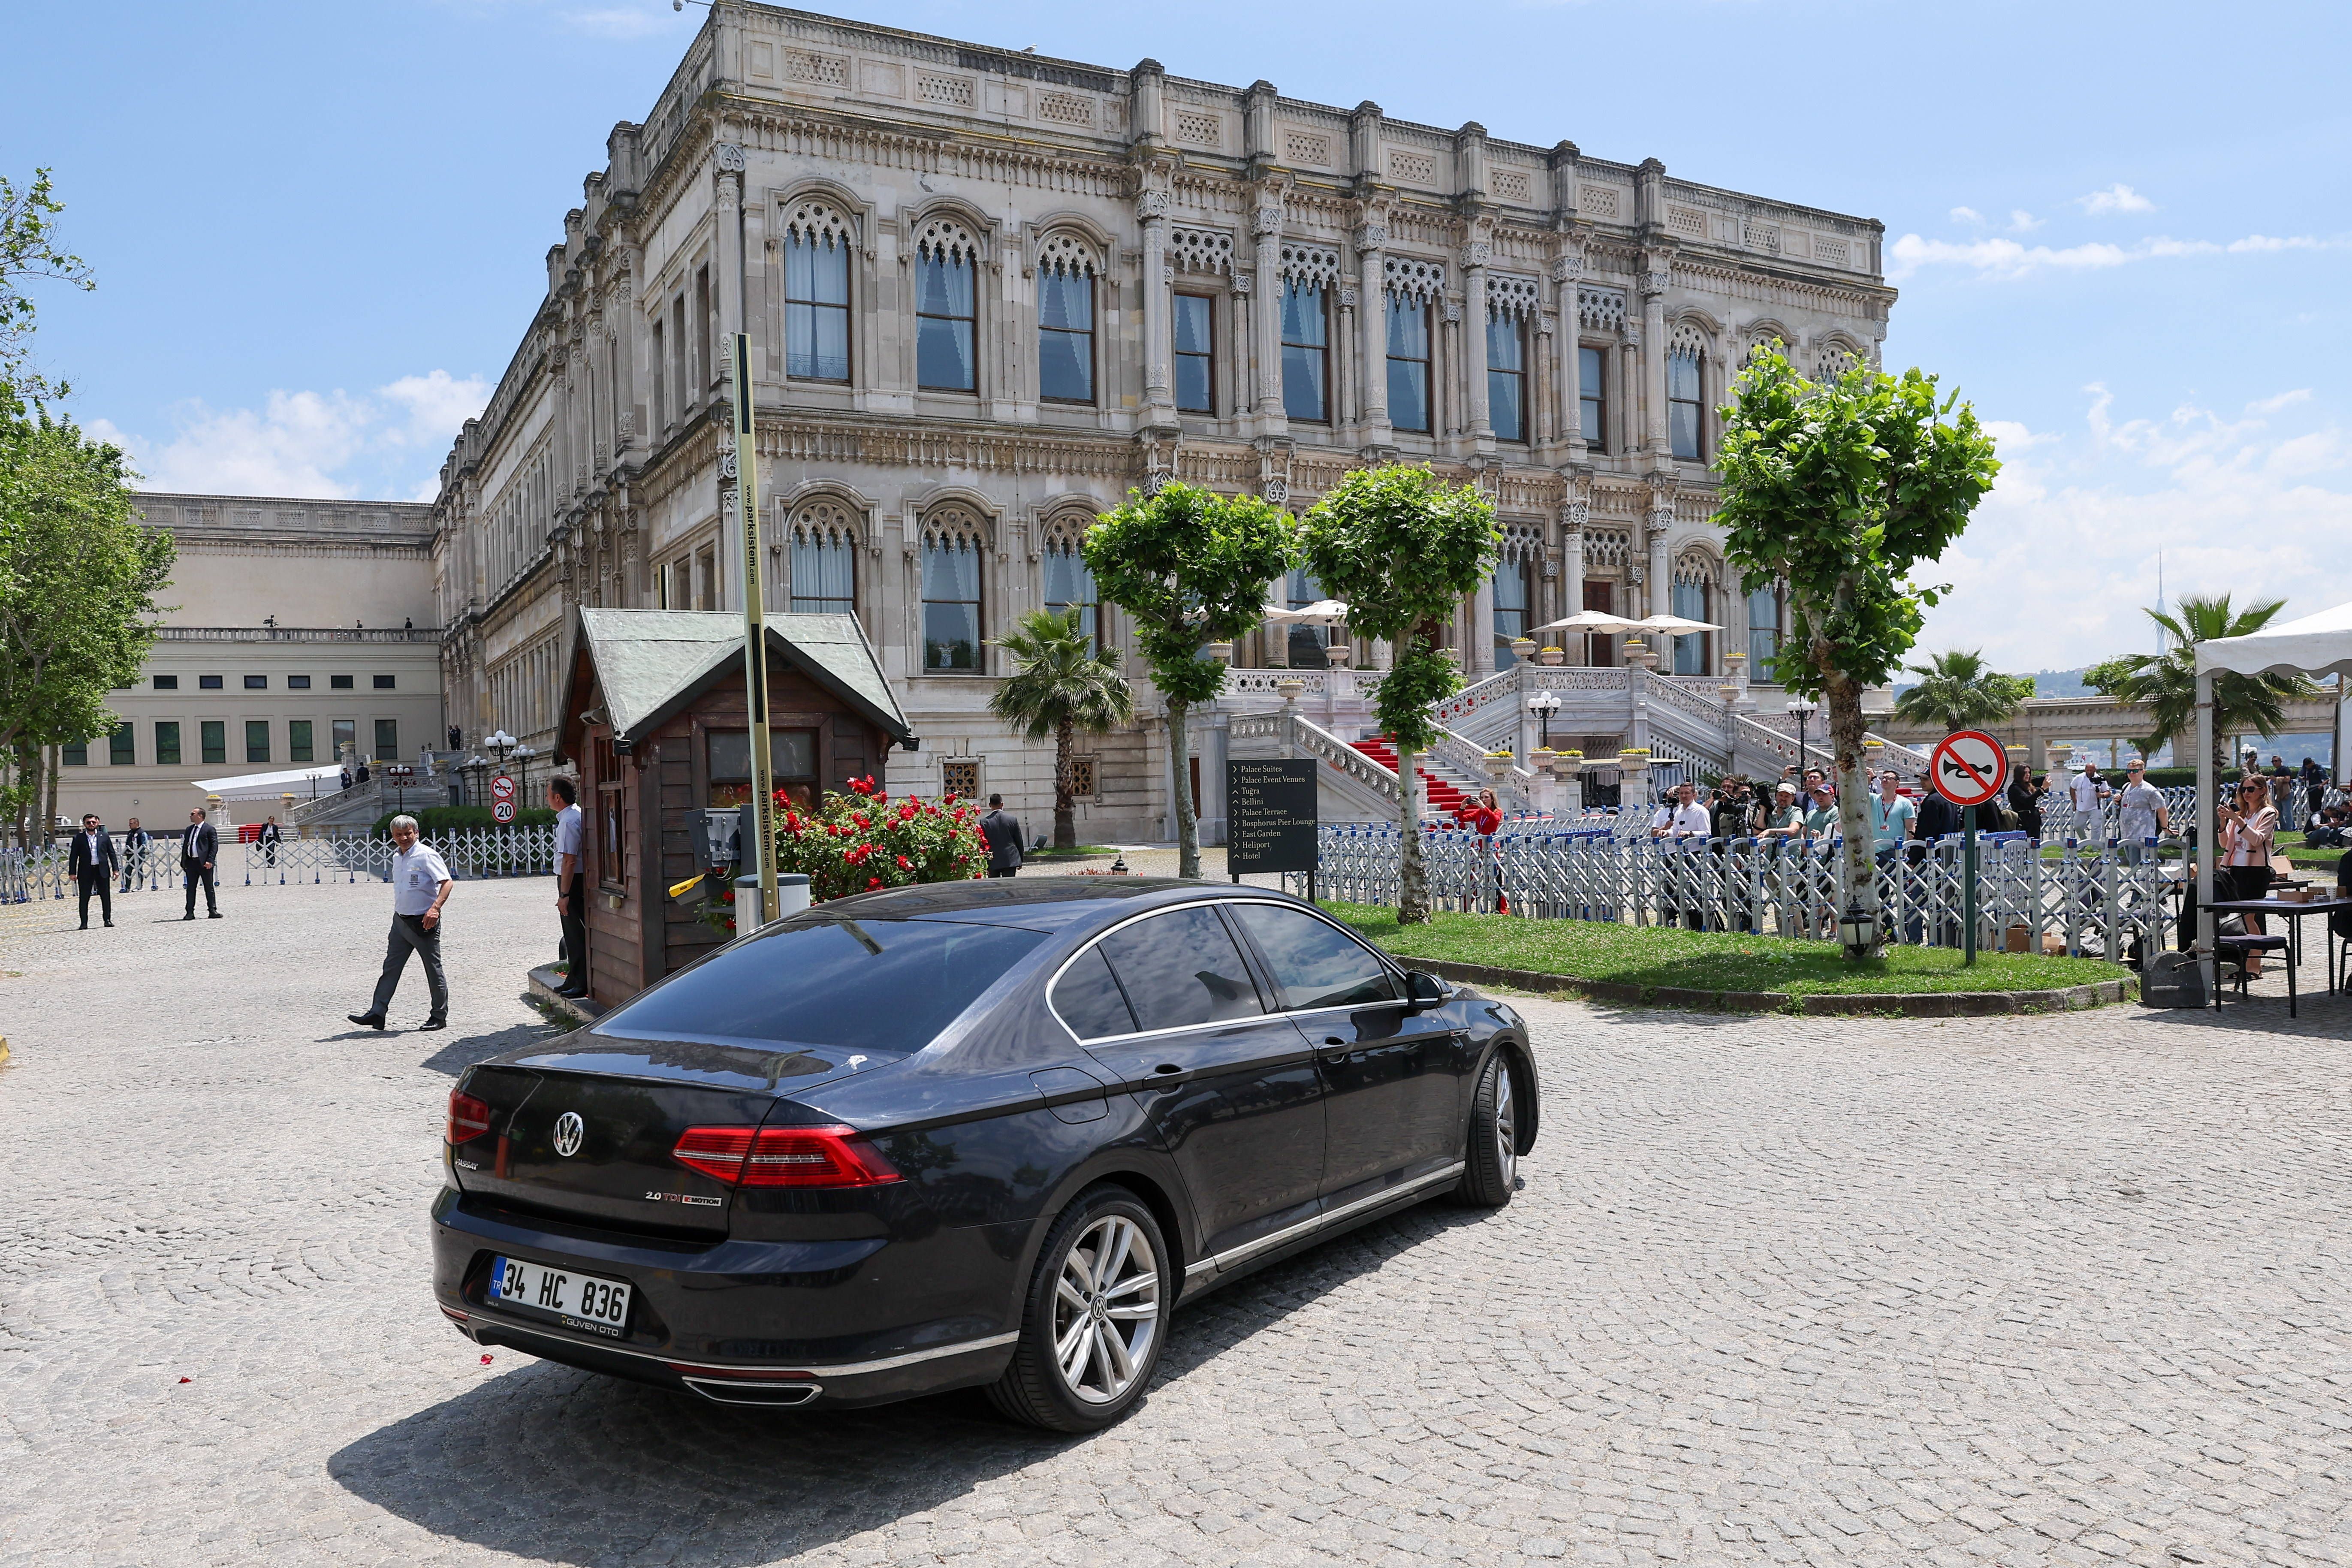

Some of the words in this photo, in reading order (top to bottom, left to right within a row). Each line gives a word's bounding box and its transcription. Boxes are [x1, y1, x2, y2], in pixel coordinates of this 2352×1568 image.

[745, 485, 756, 584] www.parksistem.com
[1241, 787, 1260, 796] Tuğra
[498, 805, 512, 817] 20
[760, 769, 771, 868] www.parksistem.com
[1242, 820, 1276, 828] Bosphorus
[1292, 818, 1315, 826] Lounge
[1242, 841, 1269, 850] Heliport
[455, 1158, 478, 1170] PASSAT
[645, 1191, 661, 1200] 2.0
[663, 1193, 681, 1202] TDI
[493, 1280, 501, 1290] TR
[502, 1263, 525, 1299] 34
[539, 1272, 567, 1309] HC
[580, 1282, 625, 1322] 836
[567, 1318, 597, 1331] GÜVEN
[600, 1326, 618, 1336] OTO
